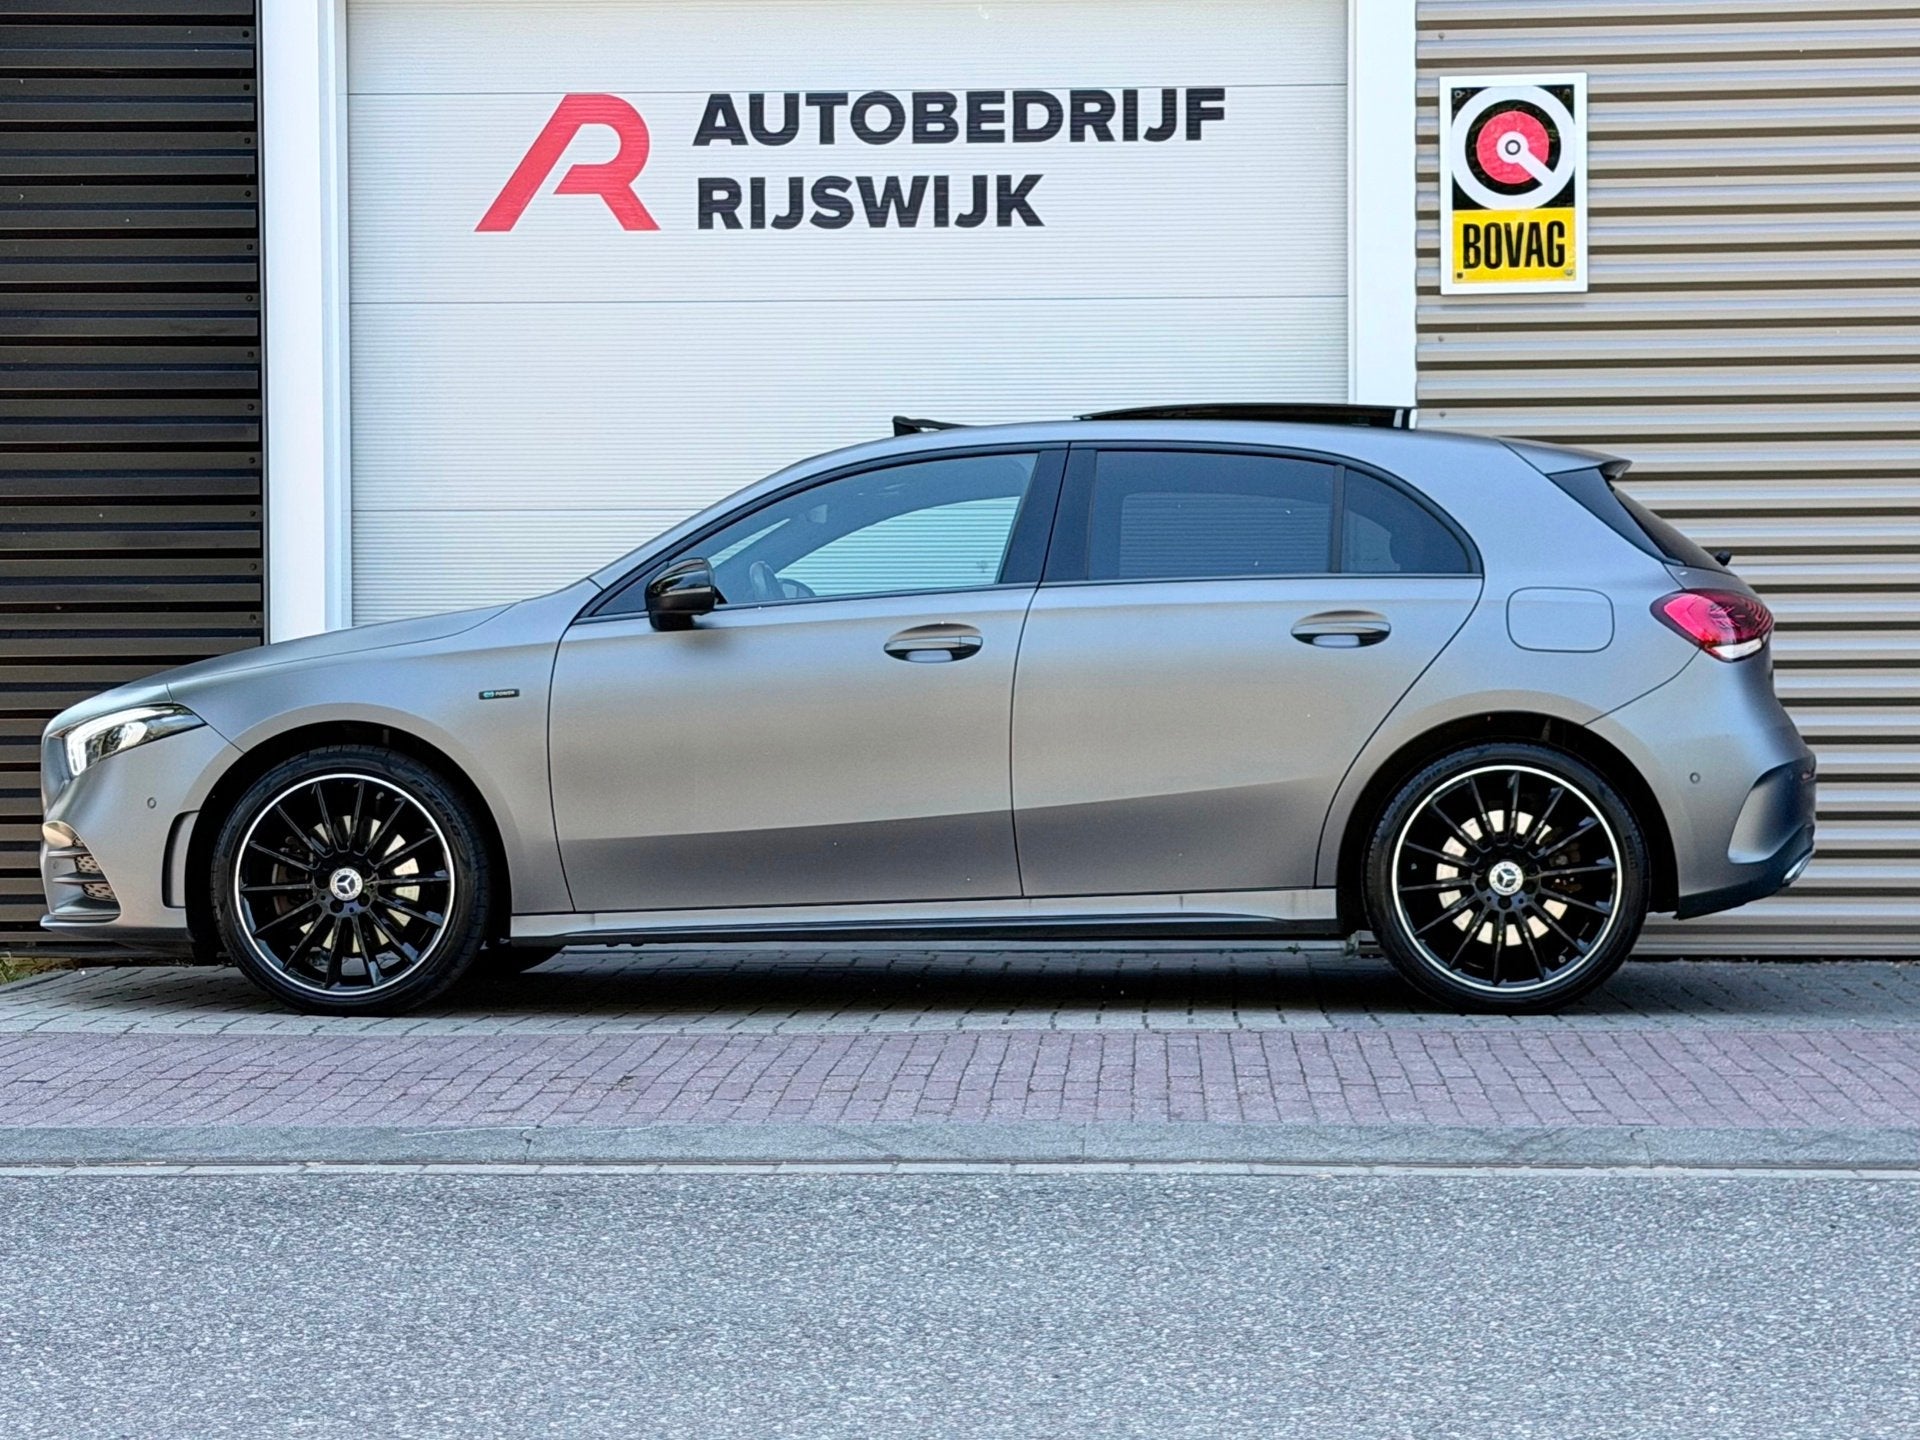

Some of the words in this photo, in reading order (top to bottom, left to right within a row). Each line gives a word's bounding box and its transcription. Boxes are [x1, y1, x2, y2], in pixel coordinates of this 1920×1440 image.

[693, 87, 1226, 146] AUTOBEDRIJF
[698, 174, 1045, 231] RIJSWIJK
[1462, 220, 1566, 270] BOVAG
